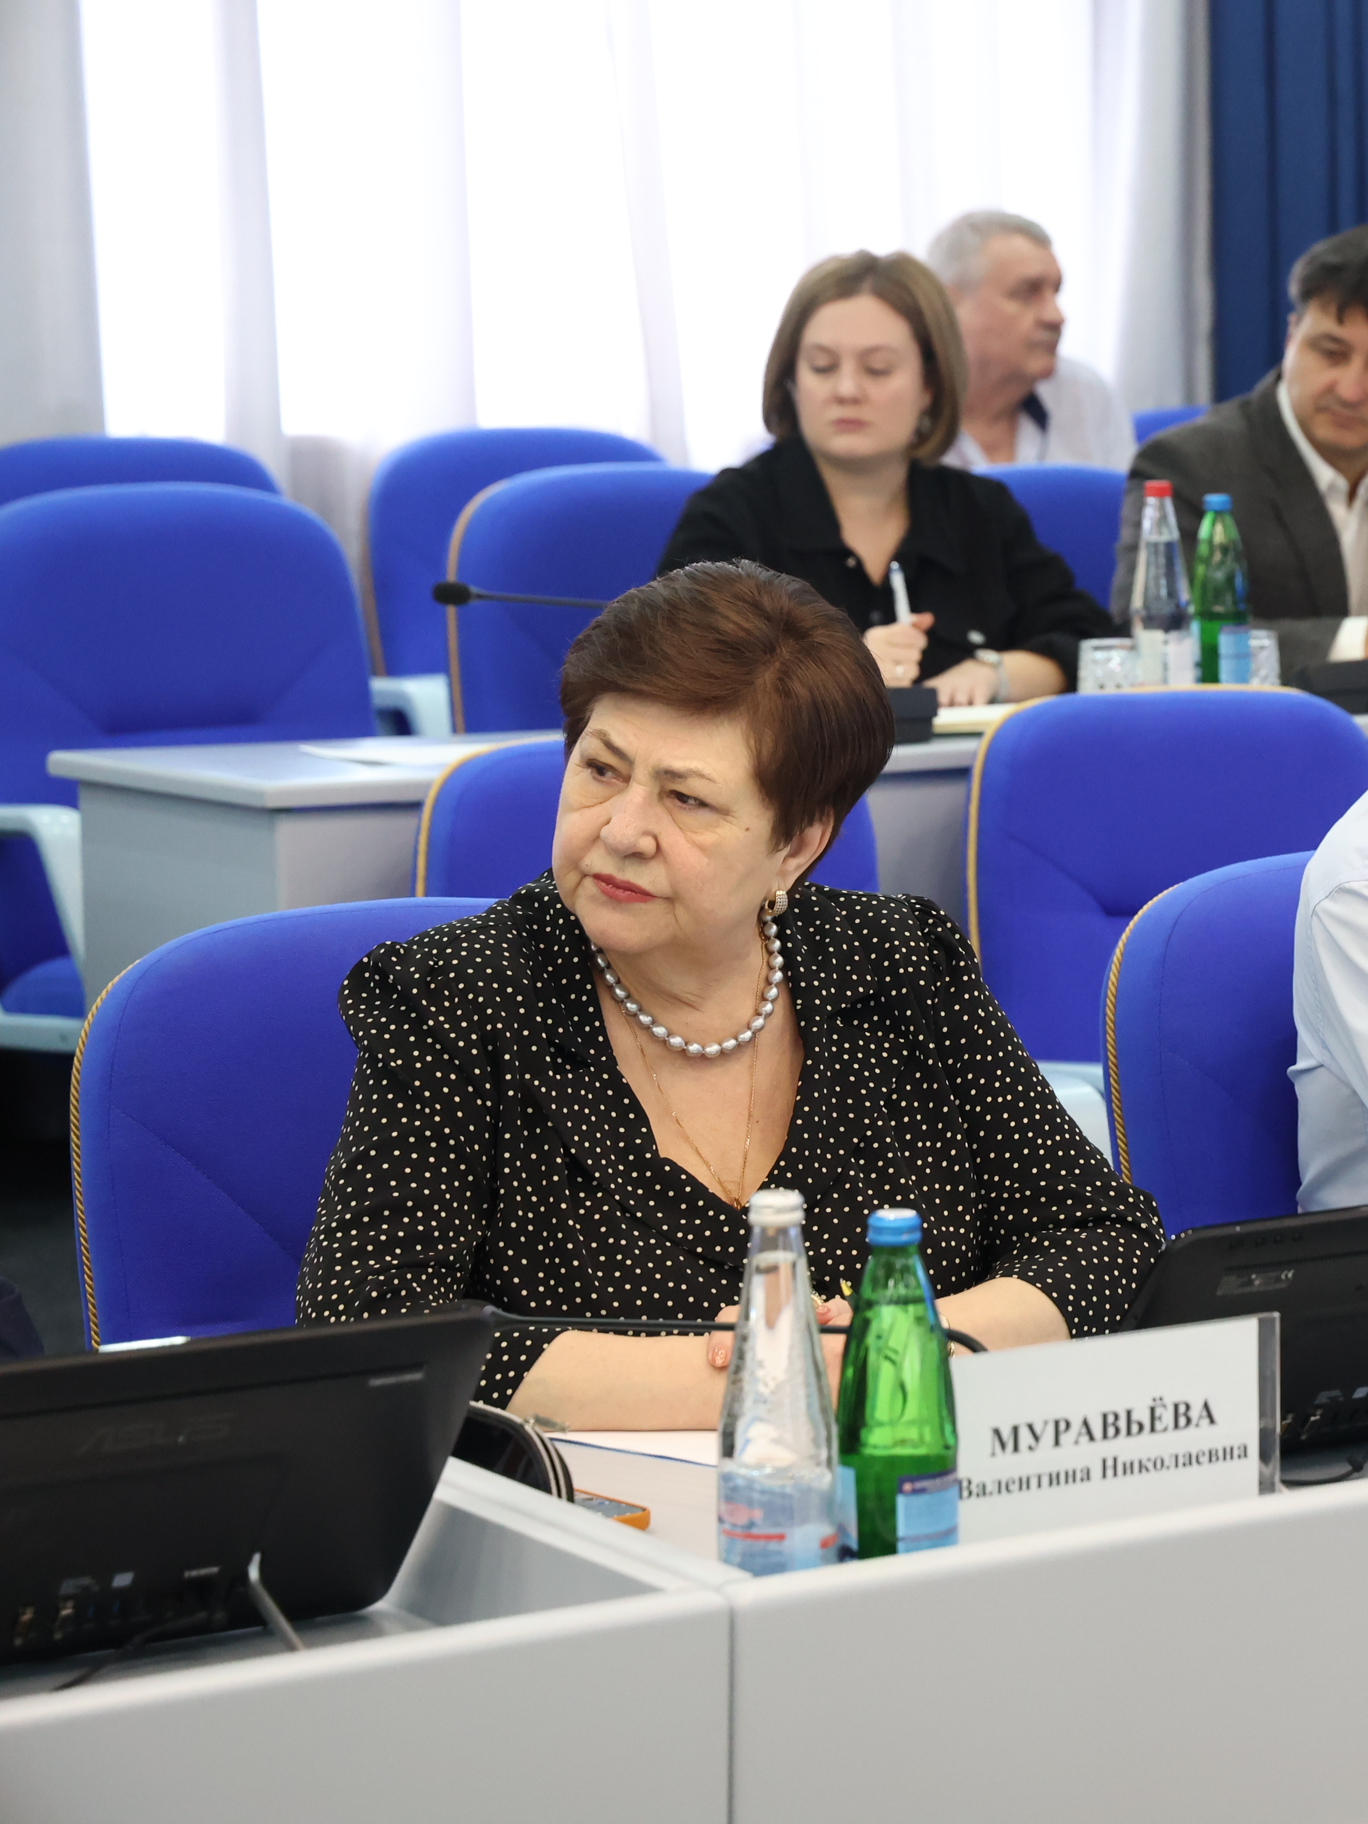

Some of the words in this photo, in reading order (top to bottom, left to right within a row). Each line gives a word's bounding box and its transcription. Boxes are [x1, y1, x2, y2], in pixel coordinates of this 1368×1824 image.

[989, 1397, 1218, 1458] МУРАВЬЁВА
[959, 1466, 1092, 1501] Валентина
[1101, 1441, 1250, 1480] Николаевна
